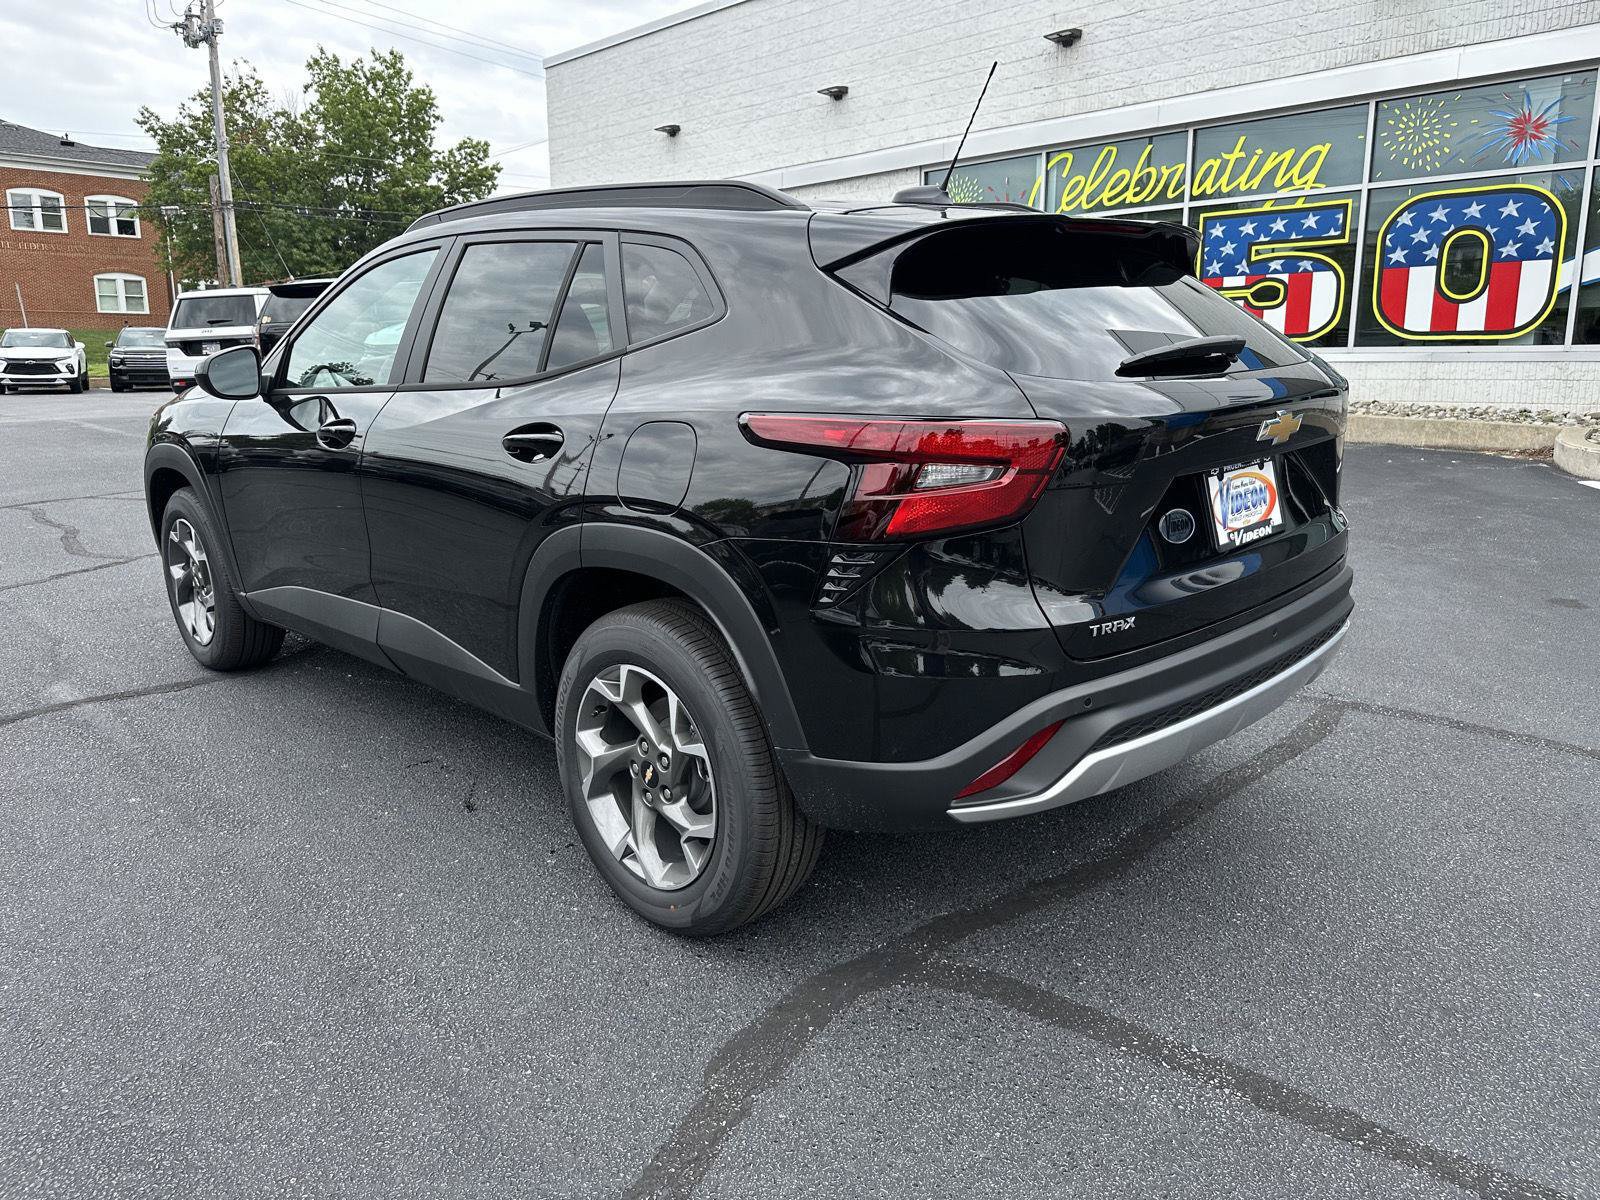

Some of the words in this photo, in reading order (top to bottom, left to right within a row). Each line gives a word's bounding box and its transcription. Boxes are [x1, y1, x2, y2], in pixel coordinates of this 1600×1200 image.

[1028, 135, 1332, 214] Celebrating
[1218, 477, 1268, 531] VIDEON
[1233, 525, 1273, 546] VIDEON
[1089, 616, 1136, 638] TRAX
